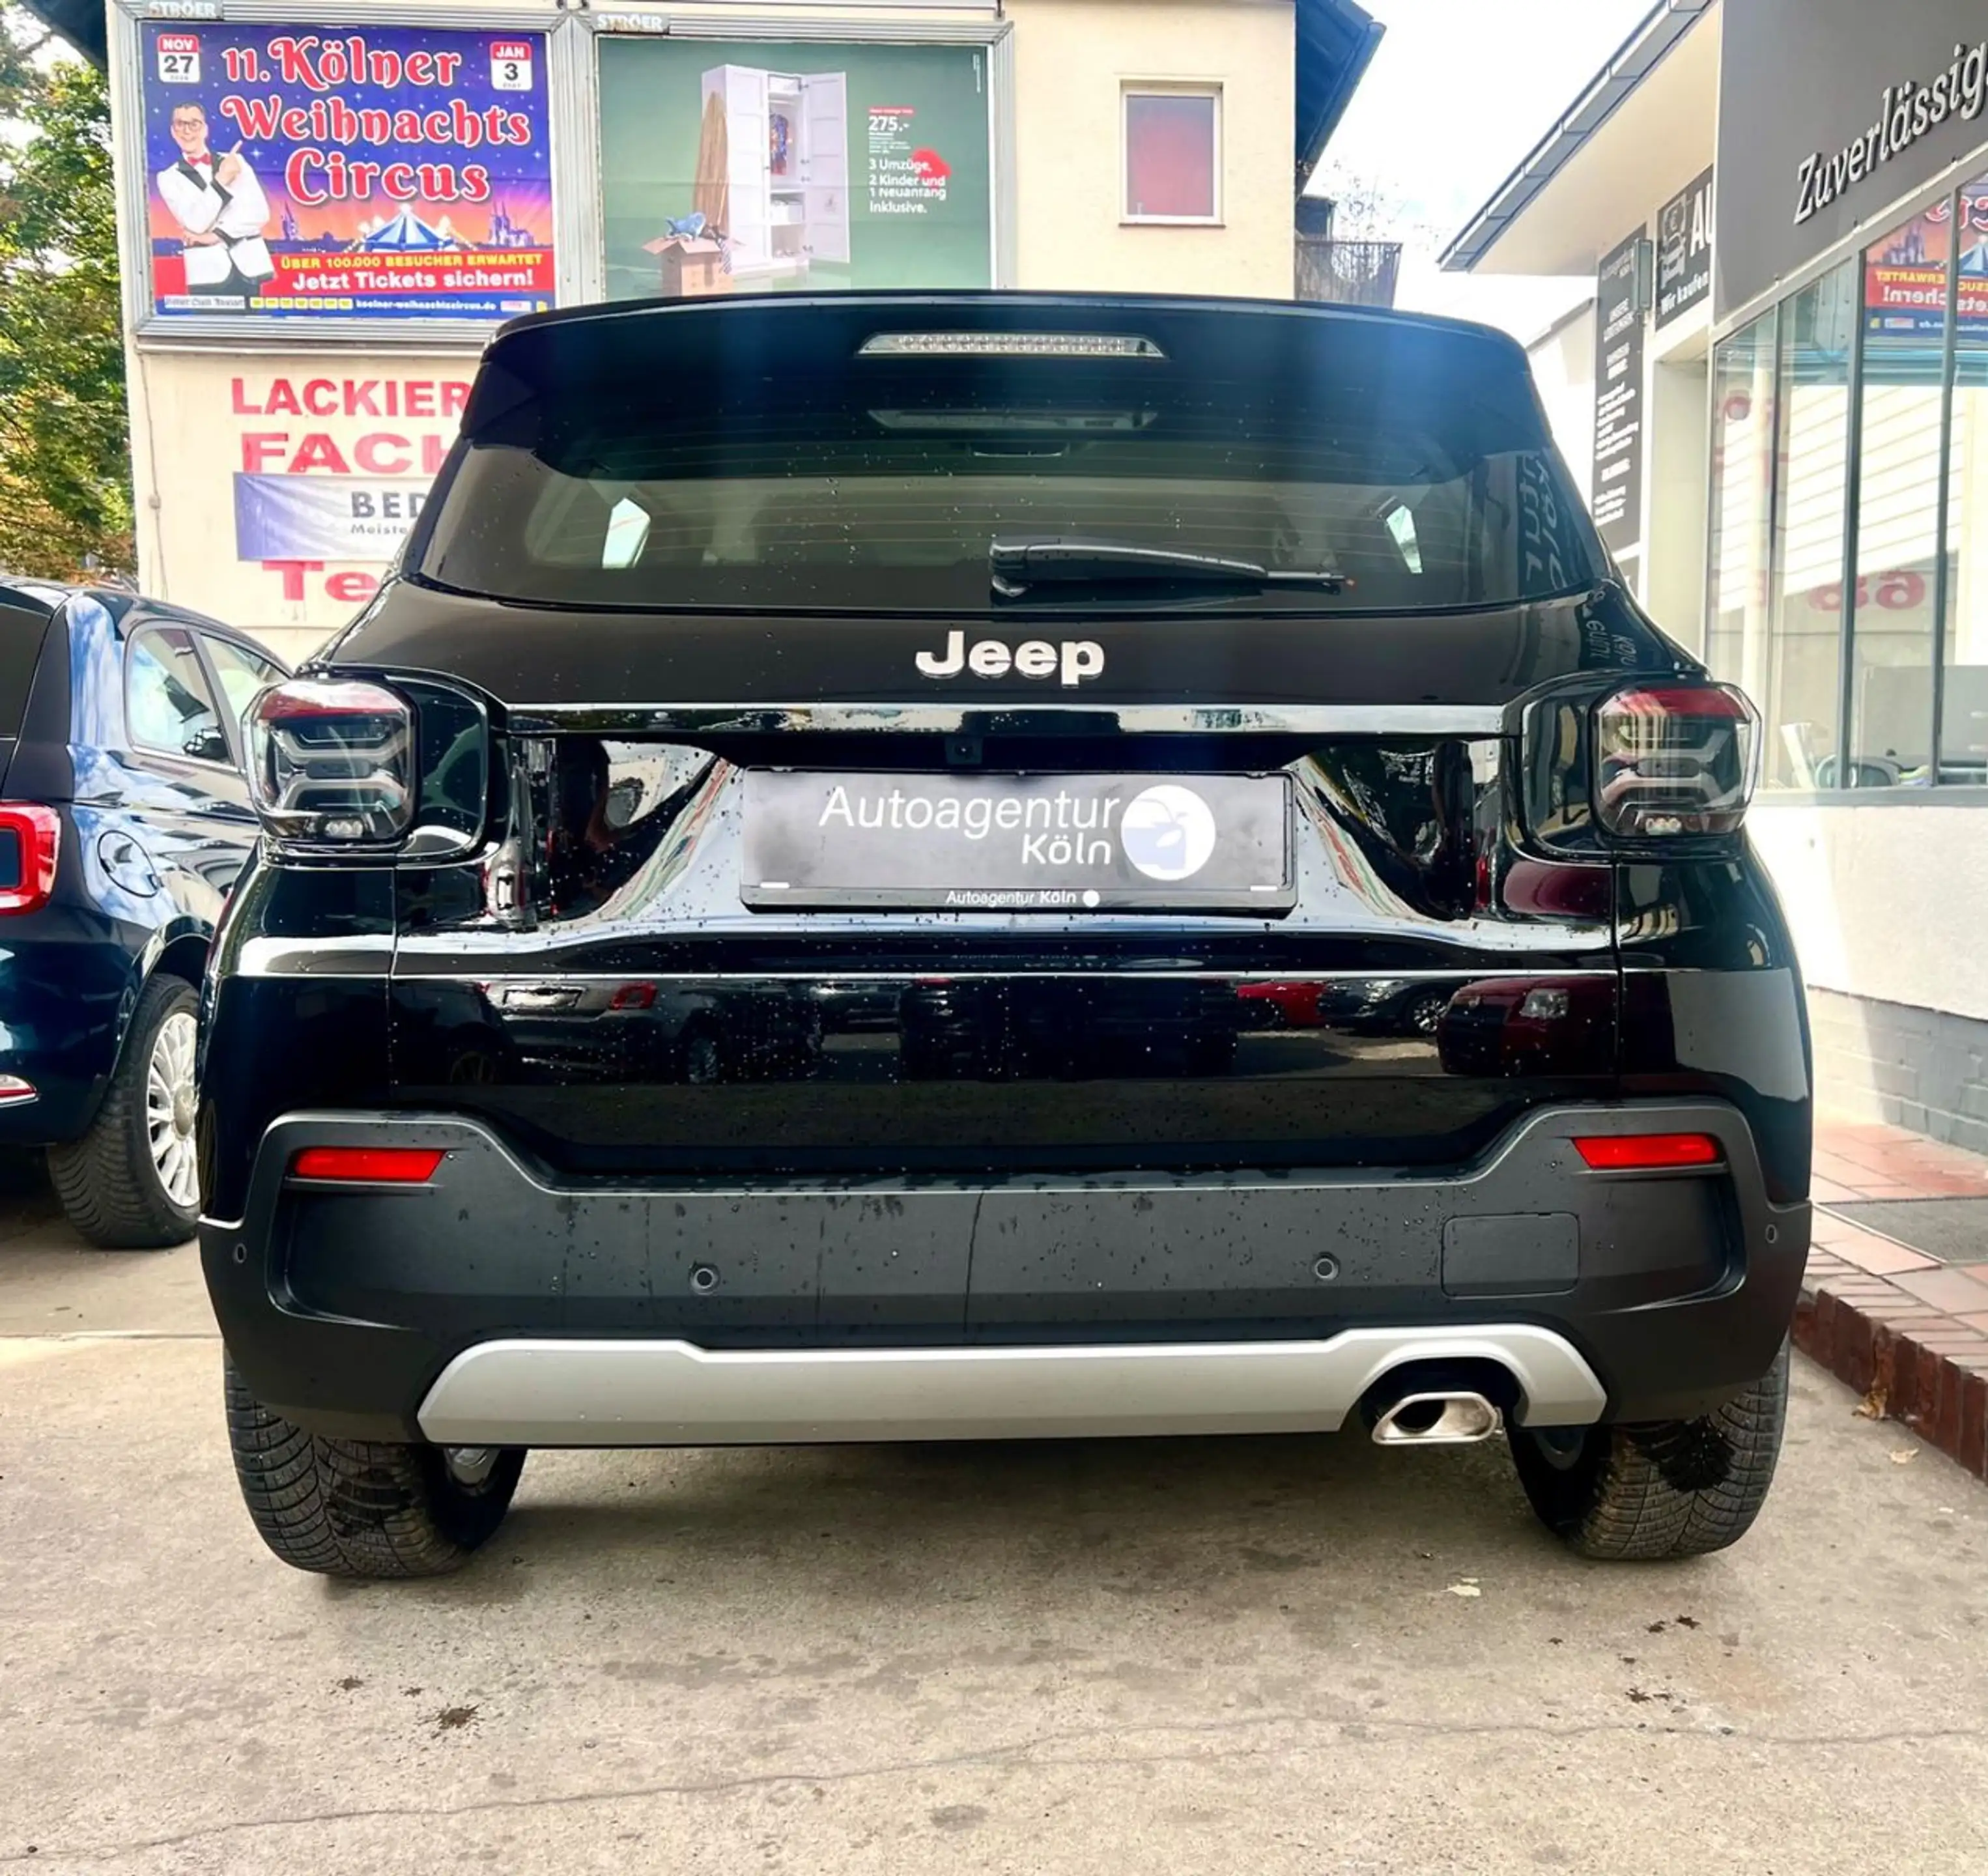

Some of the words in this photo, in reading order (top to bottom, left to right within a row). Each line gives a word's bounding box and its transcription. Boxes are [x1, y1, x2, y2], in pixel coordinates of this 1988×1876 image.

[163, 38, 193, 51] NOV
[496, 46, 524, 58] JAN
[163, 55, 193, 74] 27
[221, 48, 271, 82] 11.
[268, 36, 461, 91] Kölner
[504, 62, 519, 81] 3
[220, 94, 531, 147] Weihnachts
[1794, 42, 1988, 225] Zuverlässig
[868, 158, 877, 170] 3
[285, 147, 490, 205] Circus
[868, 175, 877, 186] 2
[879, 174, 919, 186] Kinder
[922, 175, 946, 186] und
[281, 256, 320, 269] ÜBER
[327, 255, 381, 268] 100.000
[386, 254, 463, 267] BESUCHER
[467, 253, 542, 266] ERWARTET
[292, 272, 350, 291] Jetzt
[354, 271, 436, 290] Tickets
[444, 270, 534, 288] sichern!
[915, 631, 1105, 689] Jeep
[819, 786, 1120, 840] Autoagentur
[1022, 832, 1111, 865] Köln
[946, 890, 1034, 907] Autoagentur
[1040, 890, 1077, 904] Köln
